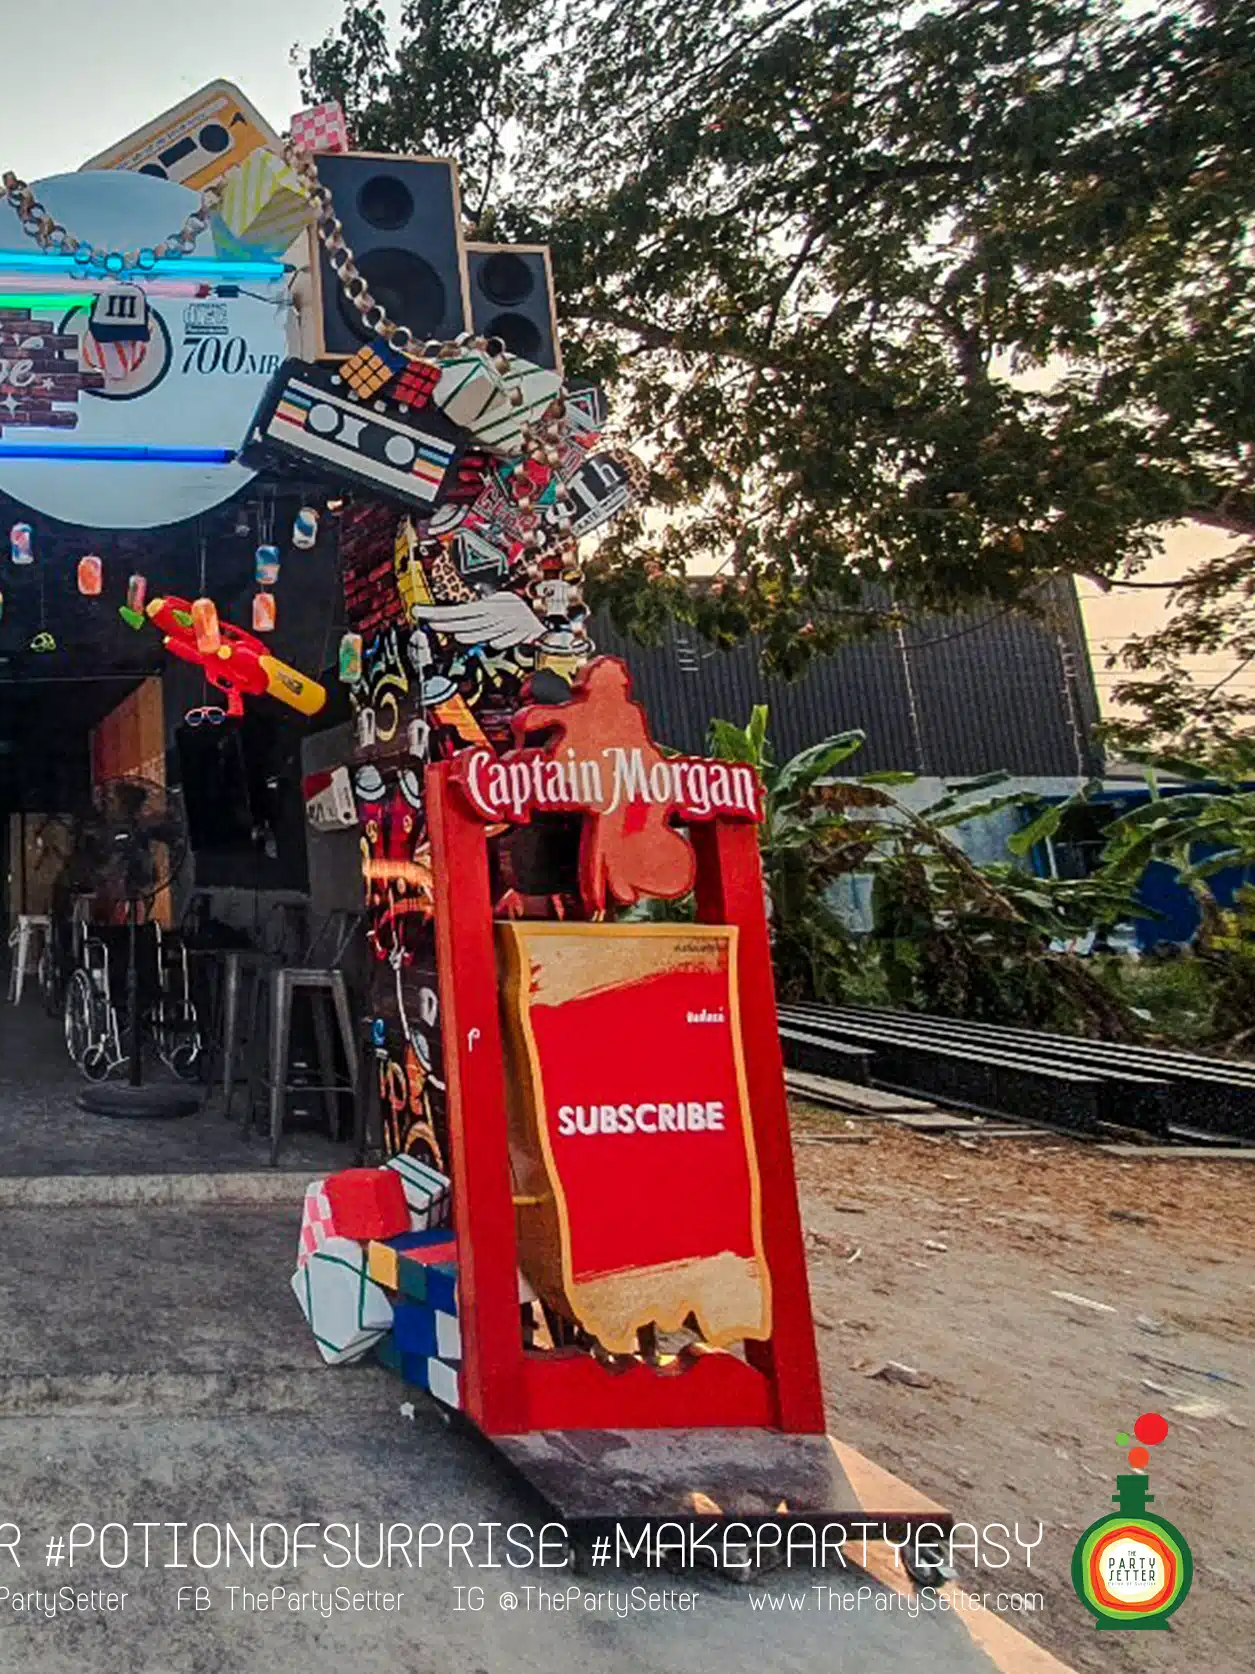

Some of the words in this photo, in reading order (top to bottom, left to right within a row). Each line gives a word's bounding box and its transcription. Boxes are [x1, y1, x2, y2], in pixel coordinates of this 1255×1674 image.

[182, 336, 247, 374] 700
[468, 747, 603, 815] Captain
[602, 747, 757, 815] Morgan
[558, 1101, 725, 1136] SUBSCRIBE
